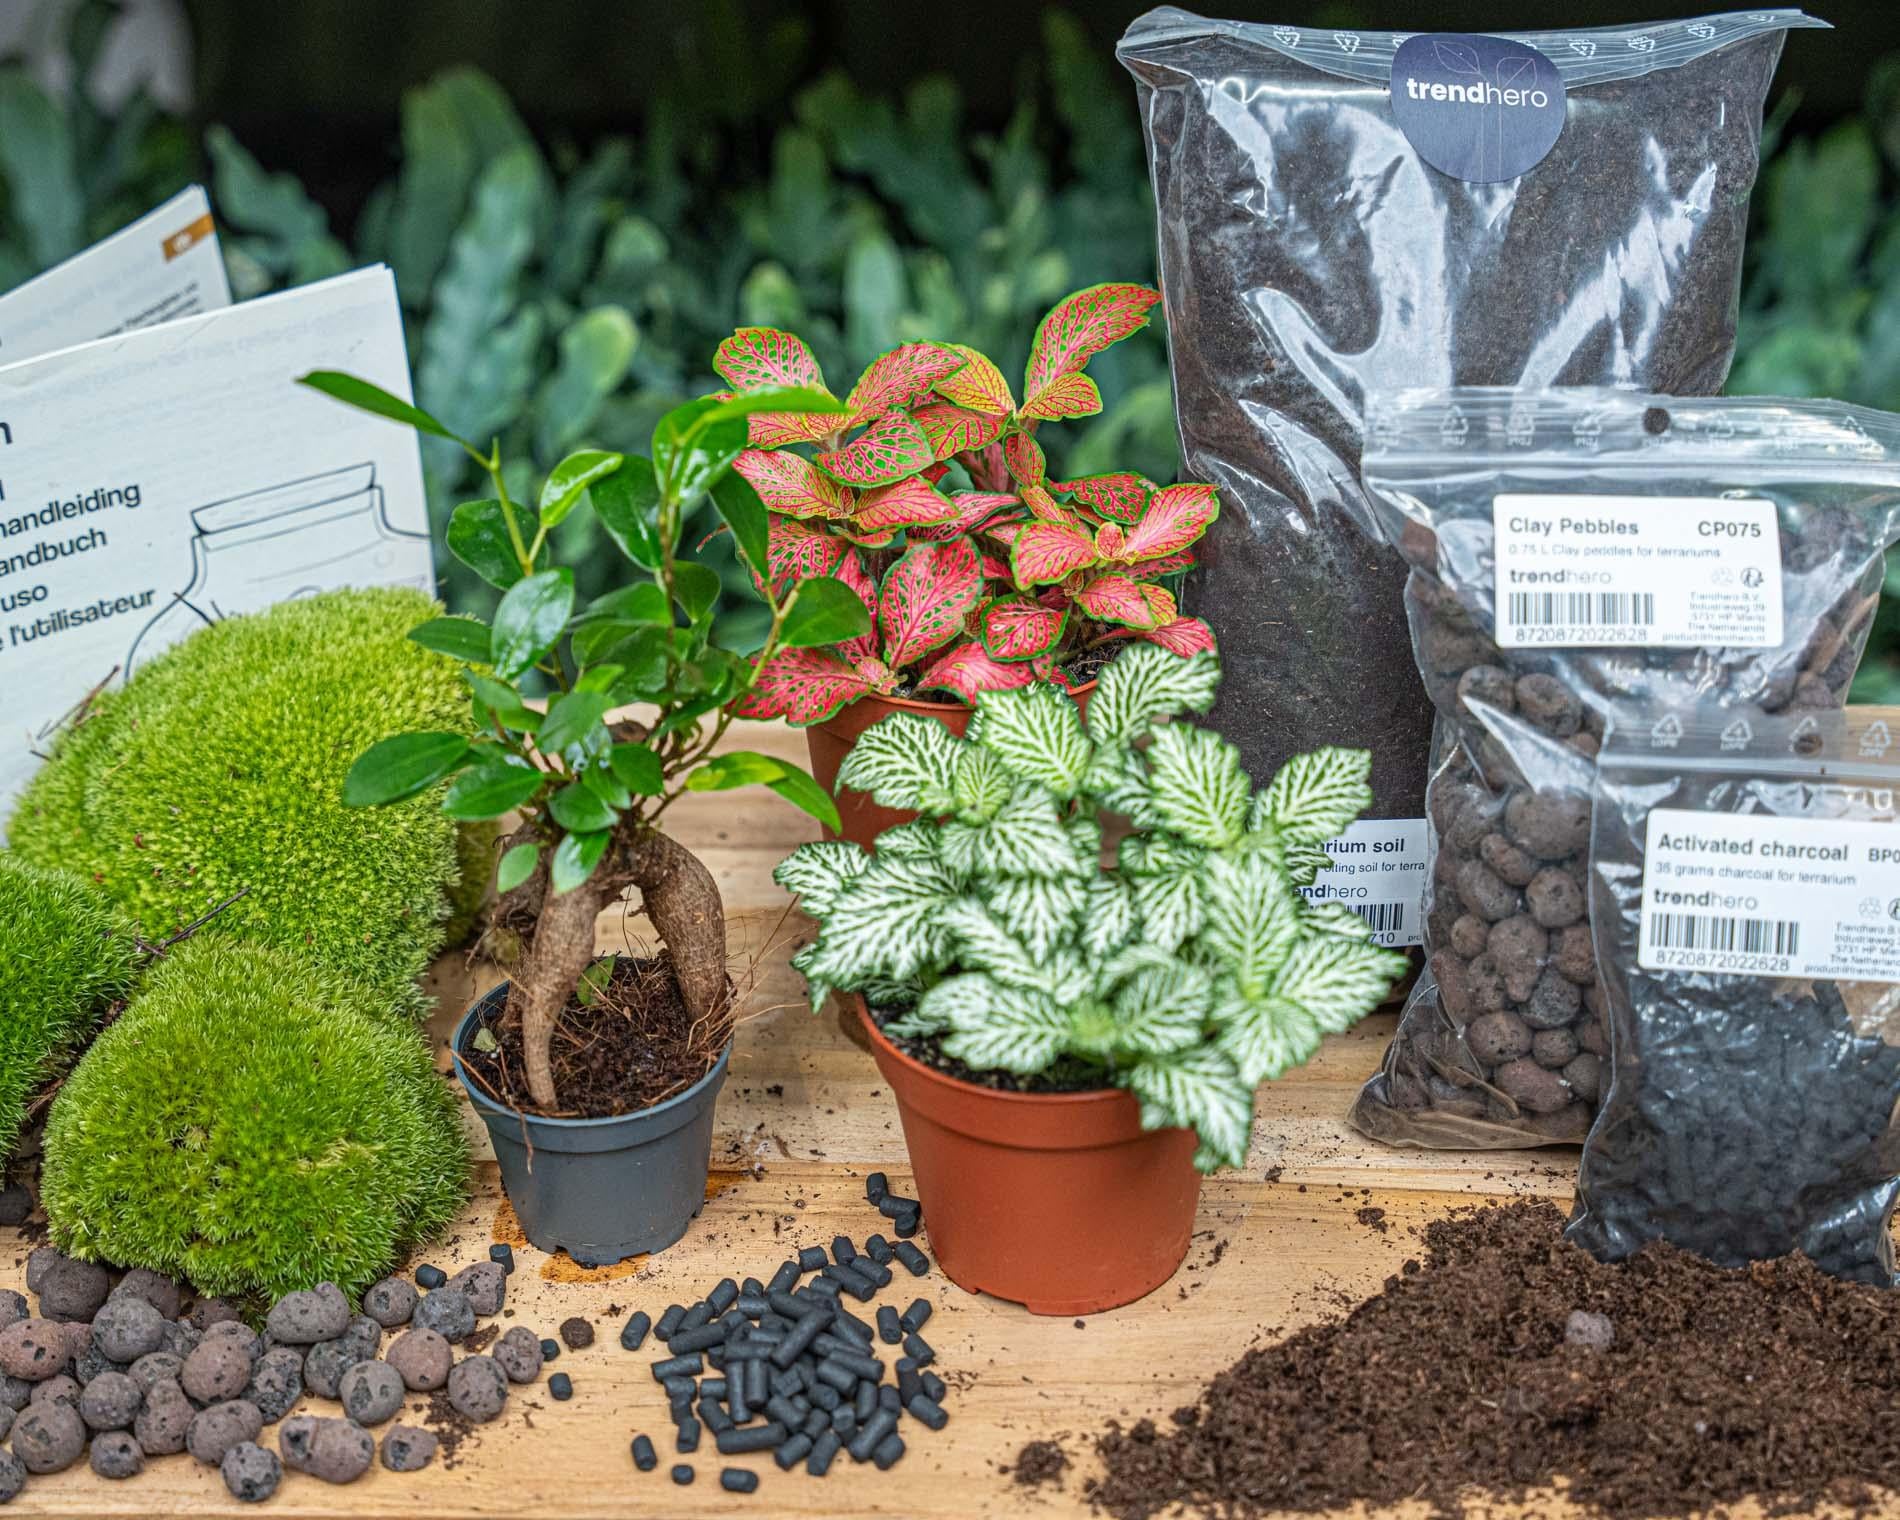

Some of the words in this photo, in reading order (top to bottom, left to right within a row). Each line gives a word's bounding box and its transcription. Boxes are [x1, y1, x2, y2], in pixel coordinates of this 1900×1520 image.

[1406, 77, 1549, 108] trendhero
[1509, 517, 1552, 536] Clay
[1560, 517, 1639, 535] Pebbles
[1697, 520, 1762, 538] CP075
[1551, 544, 1580, 557] Clay
[1636, 544, 1652, 556] for
[1656, 545, 1721, 558] terrariums
[1509, 568, 1612, 584] trendhero
[10, 589, 156, 647] l'utilisateur
[1372, 838, 1405, 853] soil
[1657, 833, 1754, 856] Activated
[1759, 840, 1849, 862] charcoal
[1358, 861, 1378, 872] soil
[1381, 861, 1396, 872] for
[1399, 862, 1425, 871] terra
[1675, 864, 1715, 878] grams
[1718, 865, 1774, 881] charcoal
[1777, 868, 1795, 882] for
[1798, 870, 1857, 885] terrarium
[1653, 888, 1759, 911] trendhero
[1655, 951, 1790, 972] 8720872022628
[1831, 953, 1848, 963] The
